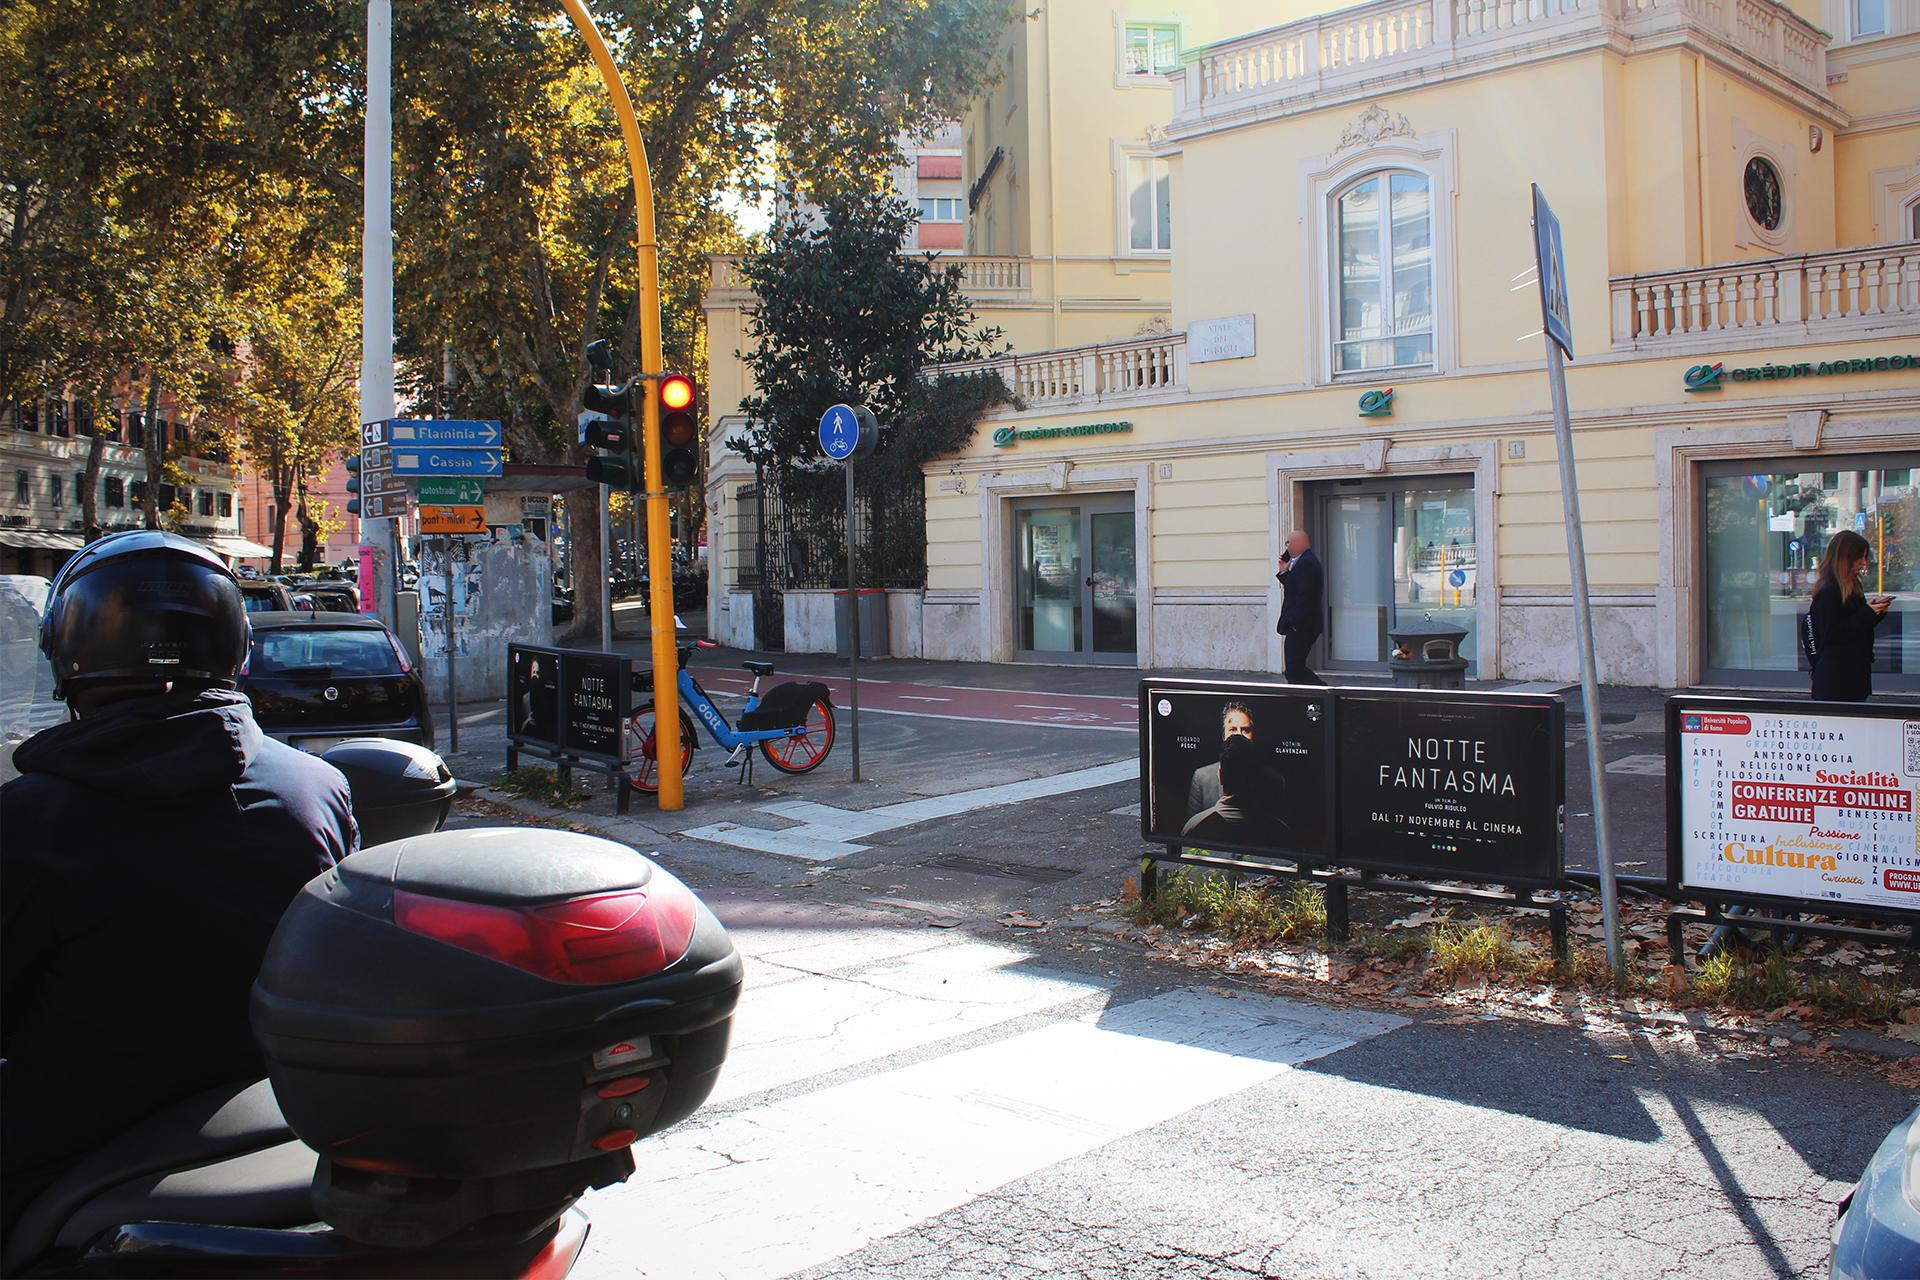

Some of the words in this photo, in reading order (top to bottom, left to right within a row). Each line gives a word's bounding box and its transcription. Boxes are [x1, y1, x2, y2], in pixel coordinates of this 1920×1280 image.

[1731, 362, 1811, 382] CRÉDIT
[419, 427, 475, 439] Flaminia
[429, 455, 473, 468] Cassia
[582, 677, 604, 693] NOTTE
[574, 693, 613, 711] FANTASMA
[698, 703, 721, 731] dott
[1756, 730, 1844, 741] LETTERATURA
[1408, 737, 1485, 764] NOTTE
[1693, 748, 1721, 757] ARTI
[1753, 751, 1853, 763] ANTROPOLOGIA
[1741, 761, 1811, 772] RELIGIONE
[1379, 766, 1516, 797] FANTASMA
[1718, 769, 1785, 781] FILOSOFIA
[1815, 769, 1900, 787] Socialità
[1733, 785, 1837, 804] CONFERENZE
[1844, 792, 1907, 809] ONLINE
[1734, 804, 1812, 822] GRATUITE
[1838, 809, 1912, 822] BENESSERE
[1371, 812, 1390, 823] DAL
[1395, 813, 1404, 824] 17
[1408, 815, 1461, 829] NOVEMBRE
[1466, 821, 1478, 831] AL
[1483, 822, 1523, 835] CINEMA
[1693, 830, 1766, 844] SCRITTURA
[1808, 826, 1861, 840] Passione
[1775, 835, 1843, 851] Inclusione
[1723, 842, 1838, 871] Cultura
